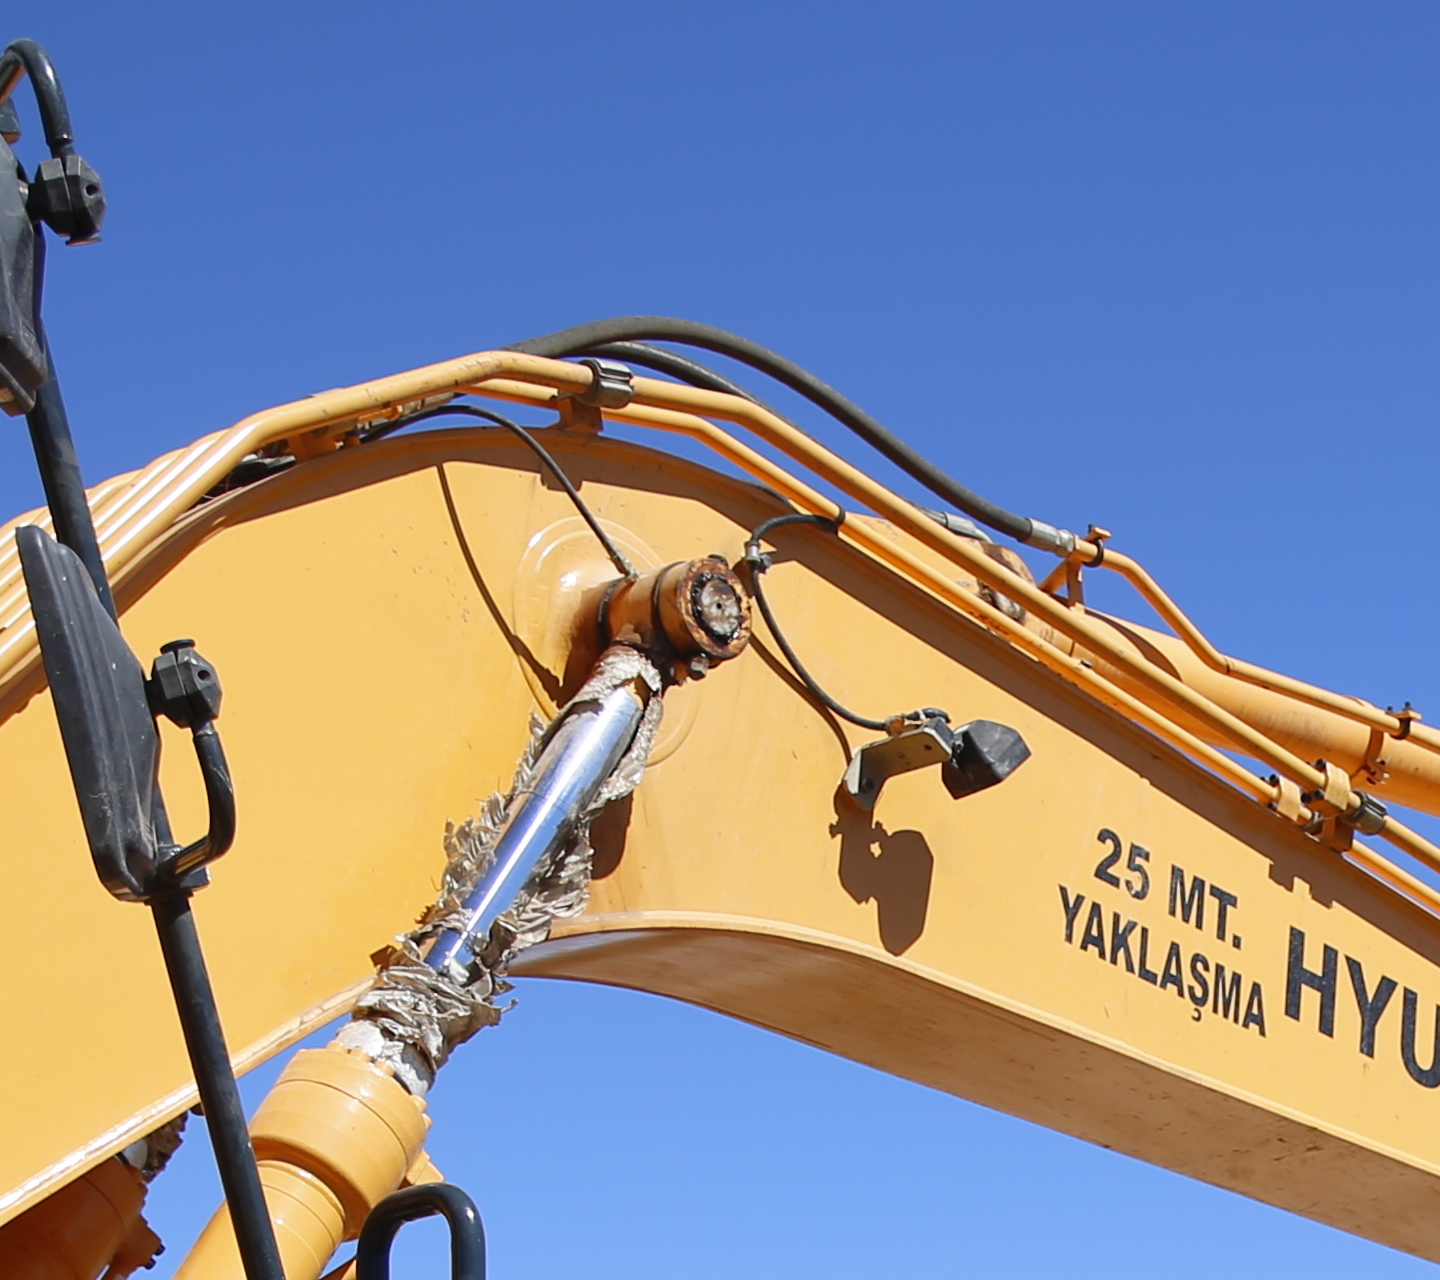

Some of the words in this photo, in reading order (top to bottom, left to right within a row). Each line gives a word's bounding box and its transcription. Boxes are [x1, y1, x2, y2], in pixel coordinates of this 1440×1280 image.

[1093, 828, 1151, 901] 25
[1168, 863, 1242, 950] MT.
[1058, 883, 1267, 1038] YAKLAŞMA
